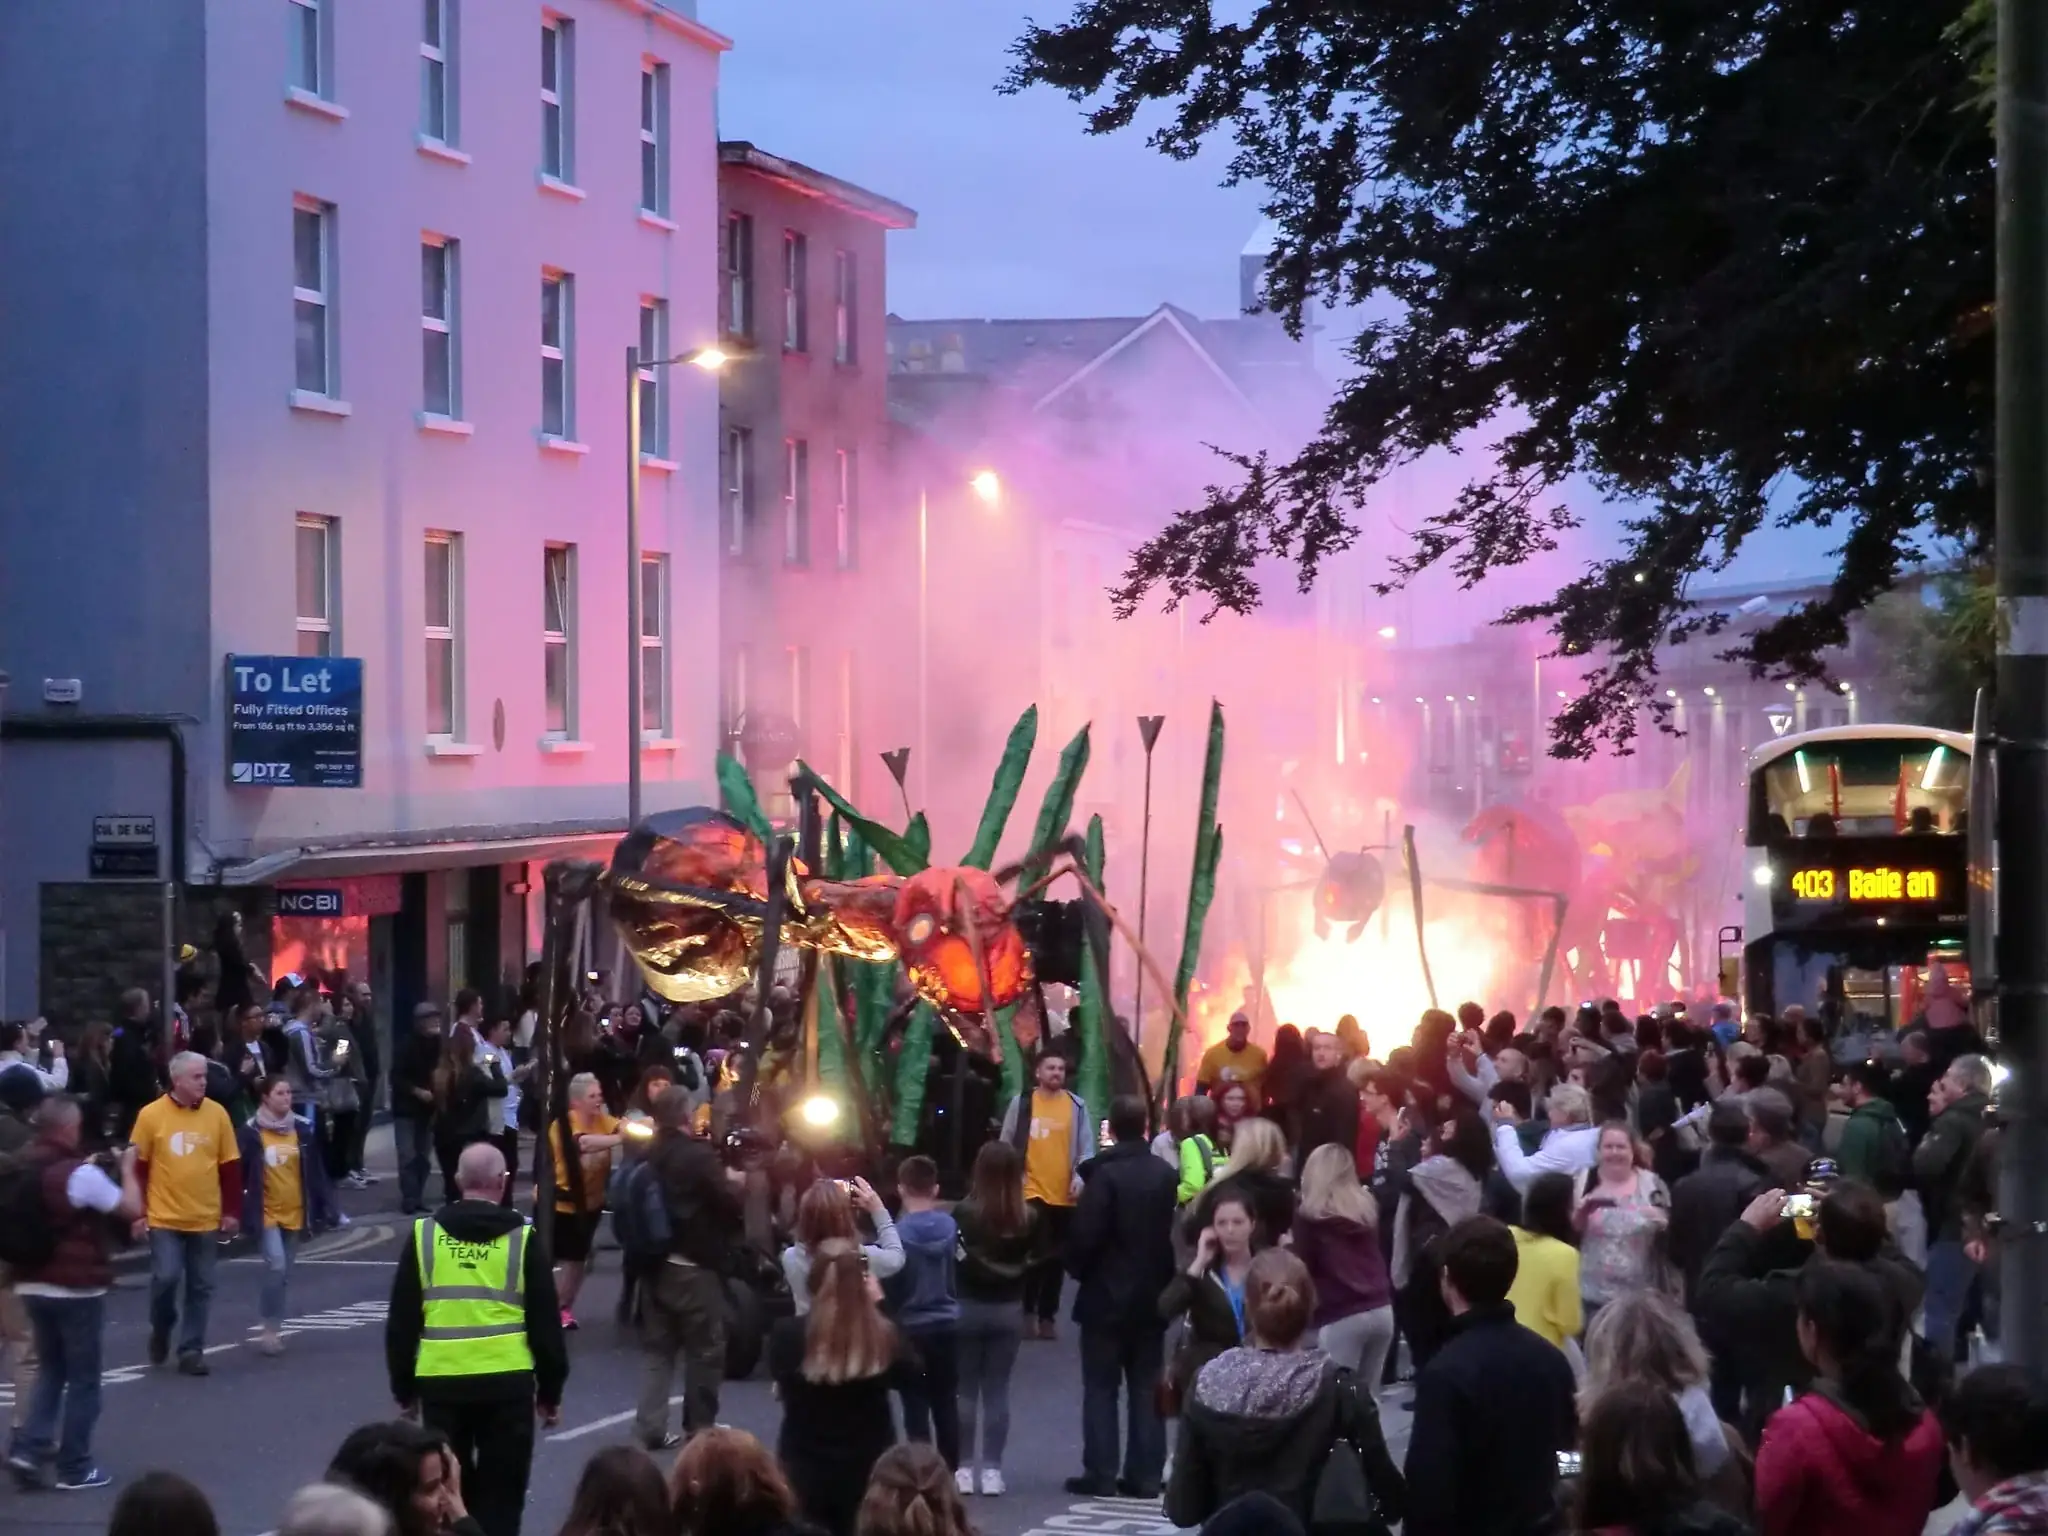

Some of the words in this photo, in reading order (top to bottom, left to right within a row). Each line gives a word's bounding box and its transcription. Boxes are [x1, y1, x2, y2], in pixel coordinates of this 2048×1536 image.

[234, 667, 272, 692] To
[282, 667, 332, 693] Let
[234, 703, 263, 717] Fully
[267, 704, 303, 715] Fitted
[306, 704, 349, 716] Offices
[233, 721, 256, 730] From
[275, 723, 285, 732] sq
[253, 763, 291, 778] DTZ
[95, 824, 113, 836] CUL
[118, 824, 131, 836] DE
[135, 824, 153, 835] SAC
[1792, 869, 1834, 898] 403
[1849, 868, 1902, 899] Baile
[1906, 871, 1936, 898] an
[281, 894, 337, 910] NCBI
[449, 1247, 488, 1260] TEAM
